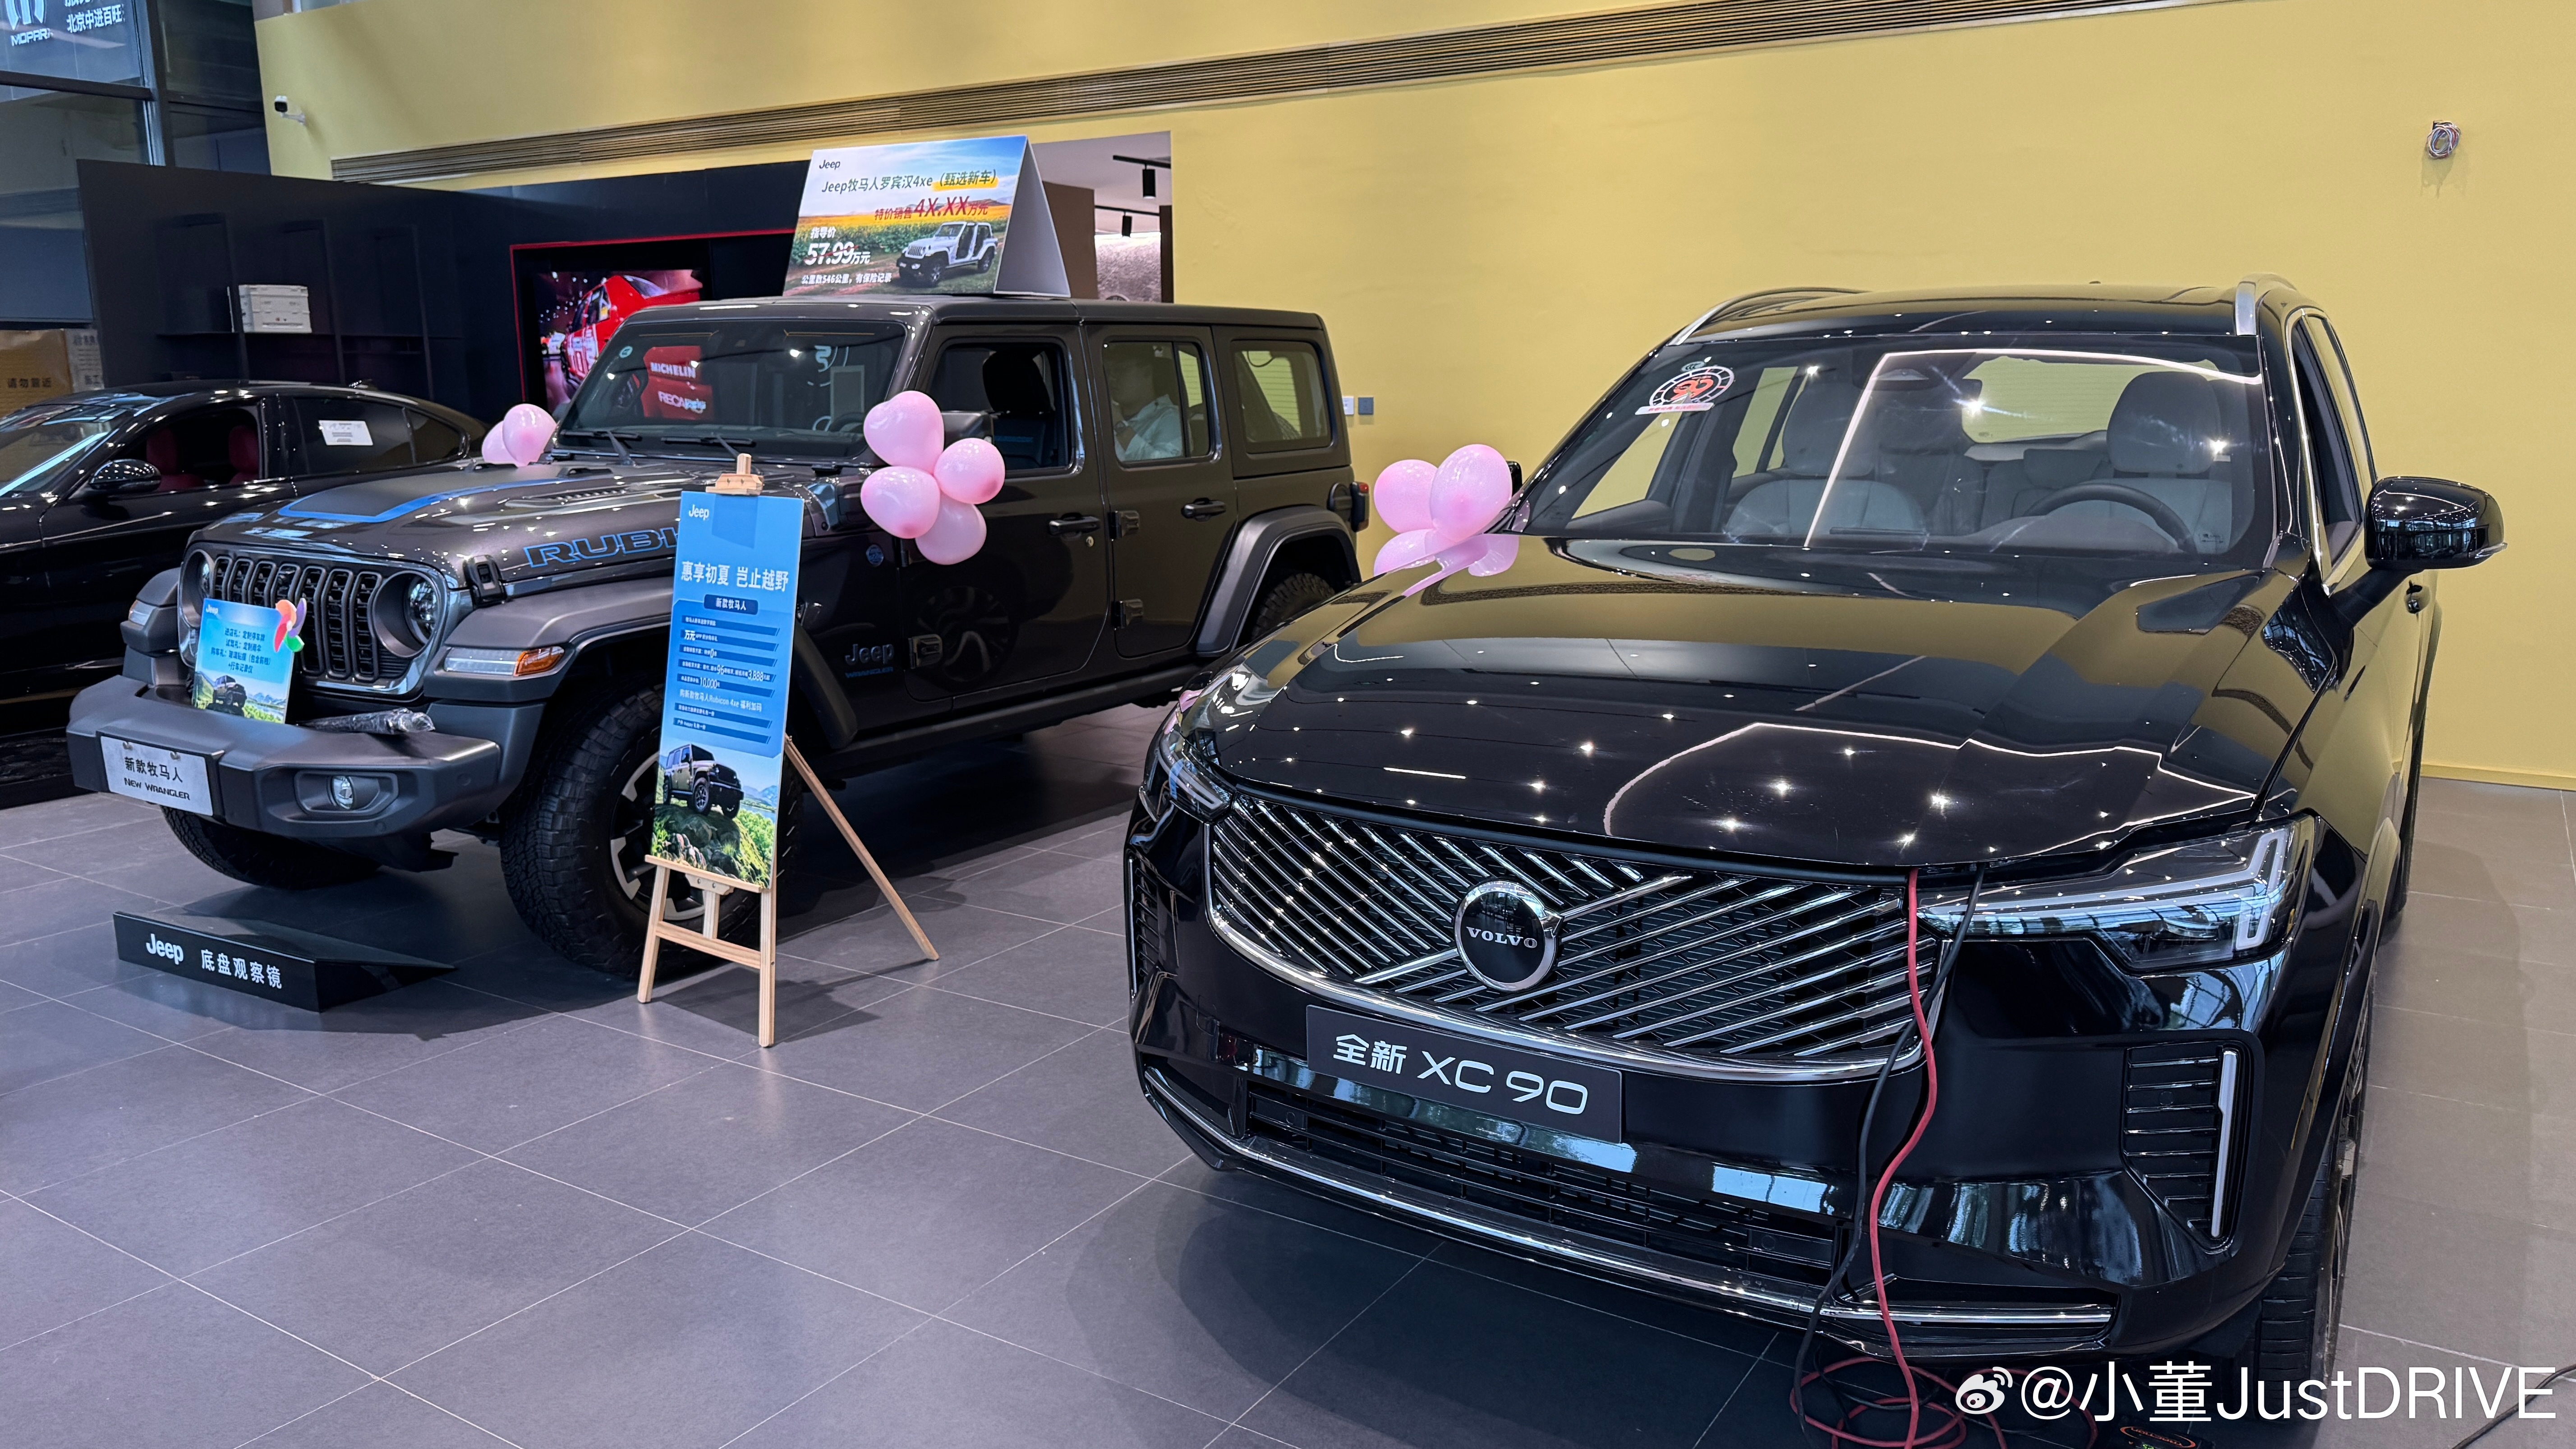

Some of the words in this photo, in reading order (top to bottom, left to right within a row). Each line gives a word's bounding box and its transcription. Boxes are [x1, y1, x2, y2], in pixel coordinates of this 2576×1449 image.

[66, 4, 123, 33] 北京中进百旺
[10, 28, 51, 46] MOPAR
[819, 160, 841, 170] Jeep
[810, 226, 837, 239] 指导价
[650, 362, 696, 379] MICHELIN
[689, 504, 709, 520] Jeep
[681, 561, 730, 586] 惠享初夏
[736, 566, 789, 592] 岂止越野
[206, 604, 219, 615] Jeep
[716, 598, 746, 611] 新款牧马人
[845, 644, 894, 665] Jeep
[124, 756, 183, 783] 新款牧马人
[124, 777, 141, 788] NEW
[145, 782, 190, 800] WRANGLER
[1466, 926, 1537, 948] VOLVO
[146, 933, 184, 965] Jeep
[201, 949, 282, 989] 底盘观察镜
[1333, 1034, 1408, 1074] 全新
